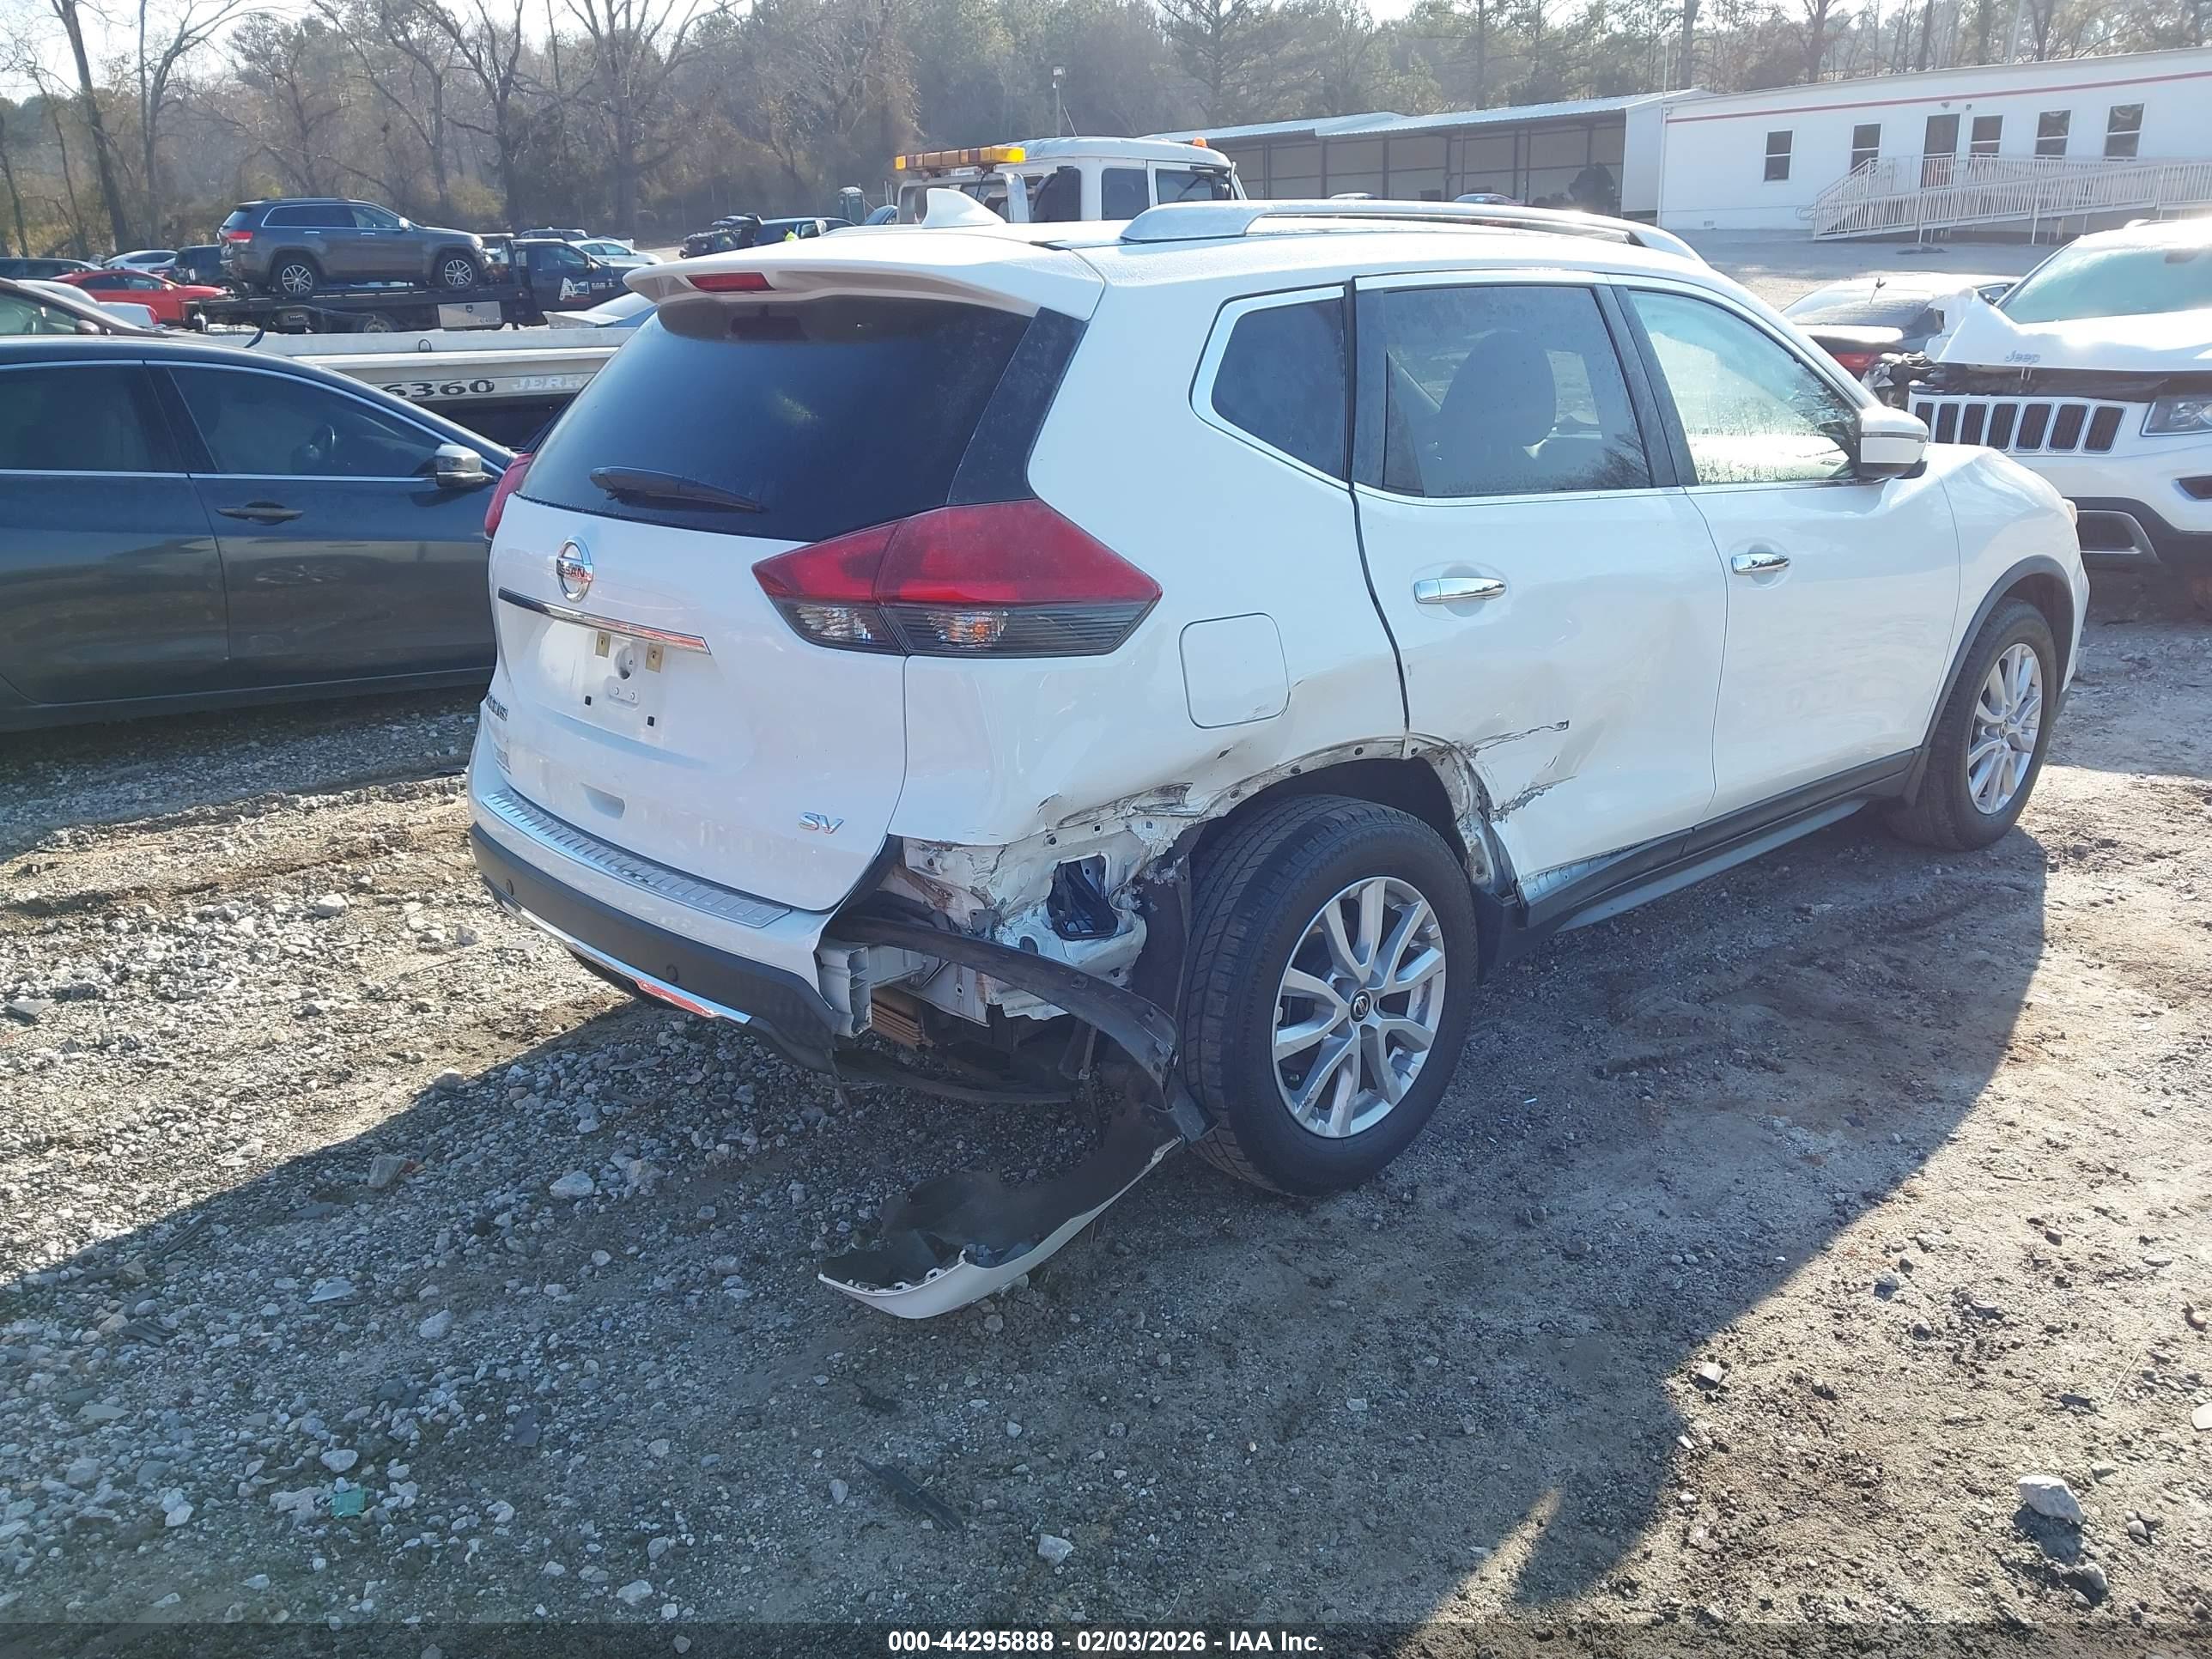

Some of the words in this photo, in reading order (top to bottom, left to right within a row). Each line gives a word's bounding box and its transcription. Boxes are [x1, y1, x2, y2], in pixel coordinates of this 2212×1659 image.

[2005, 349, 2041, 364] Jeep
[380, 379, 495, 398] 6360
[799, 811, 845, 834] SV
